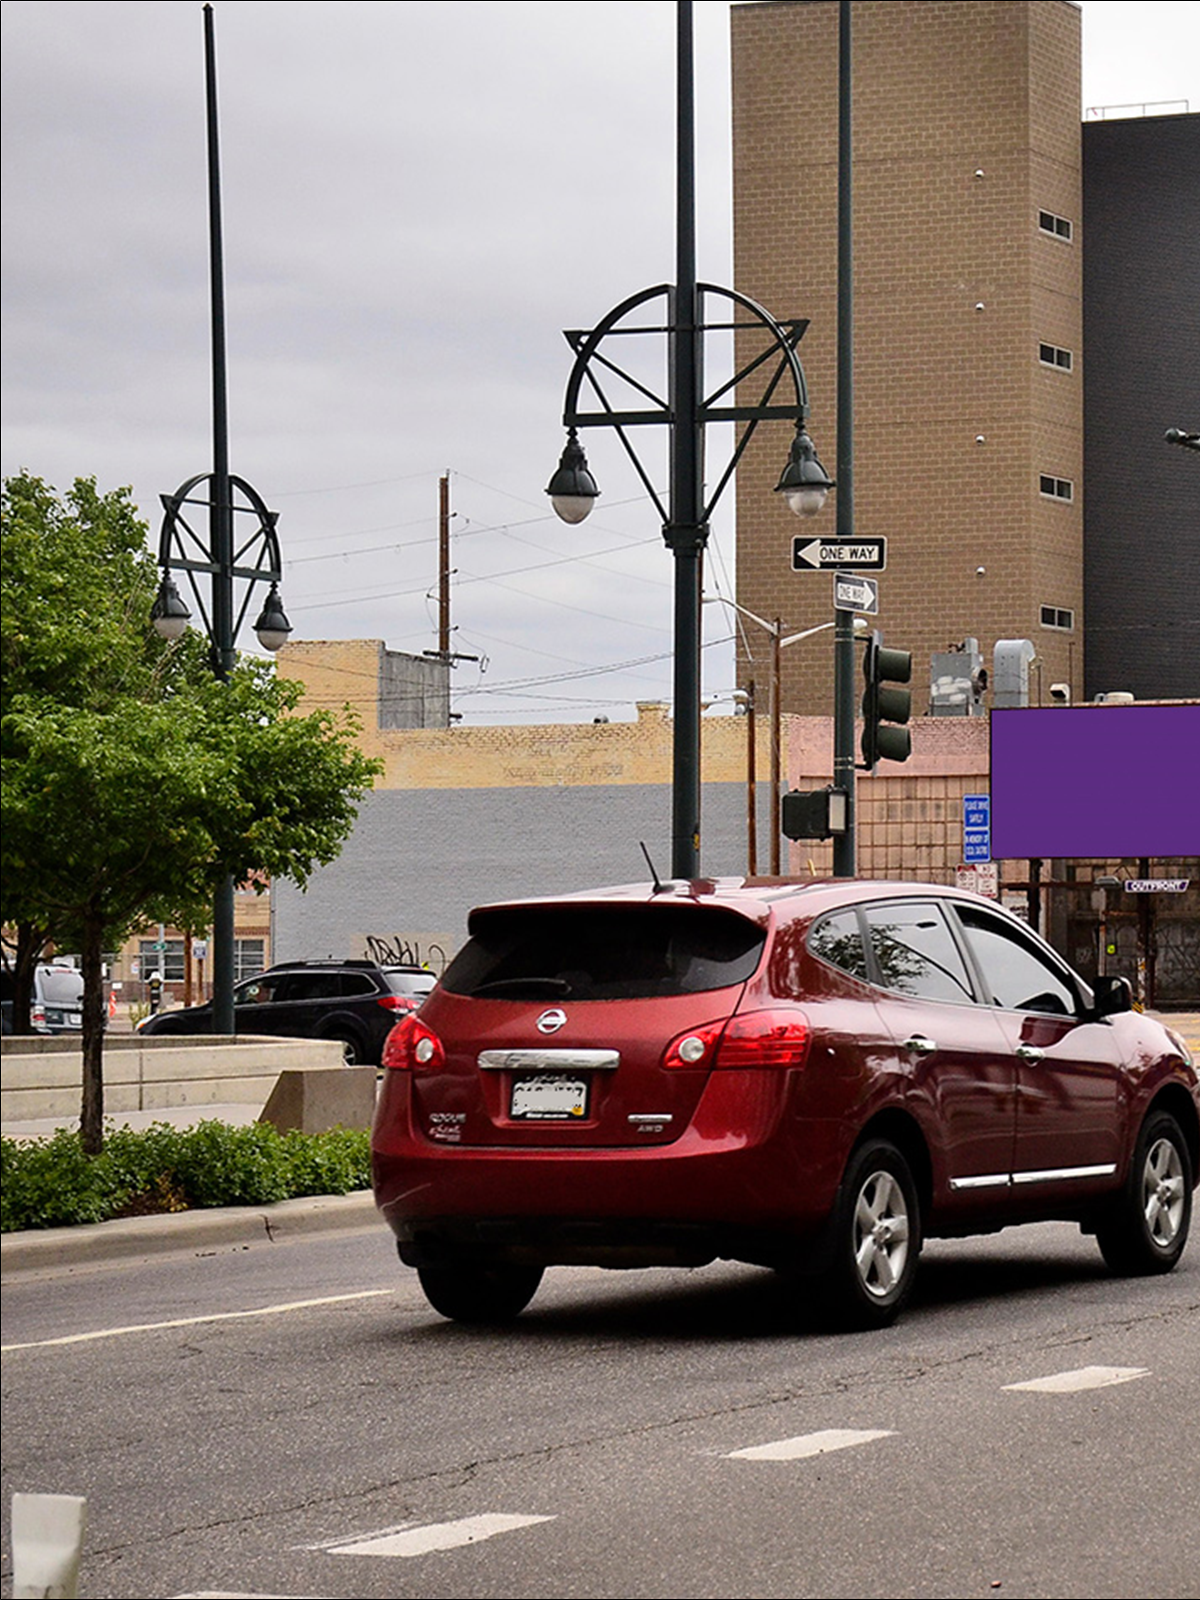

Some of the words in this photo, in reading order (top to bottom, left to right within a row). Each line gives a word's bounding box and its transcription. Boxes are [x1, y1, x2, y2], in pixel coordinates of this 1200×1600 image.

[820, 547, 845, 560] ONE
[849, 547, 875, 560] WAY
[1131, 880, 1181, 891] OUTFRONT
